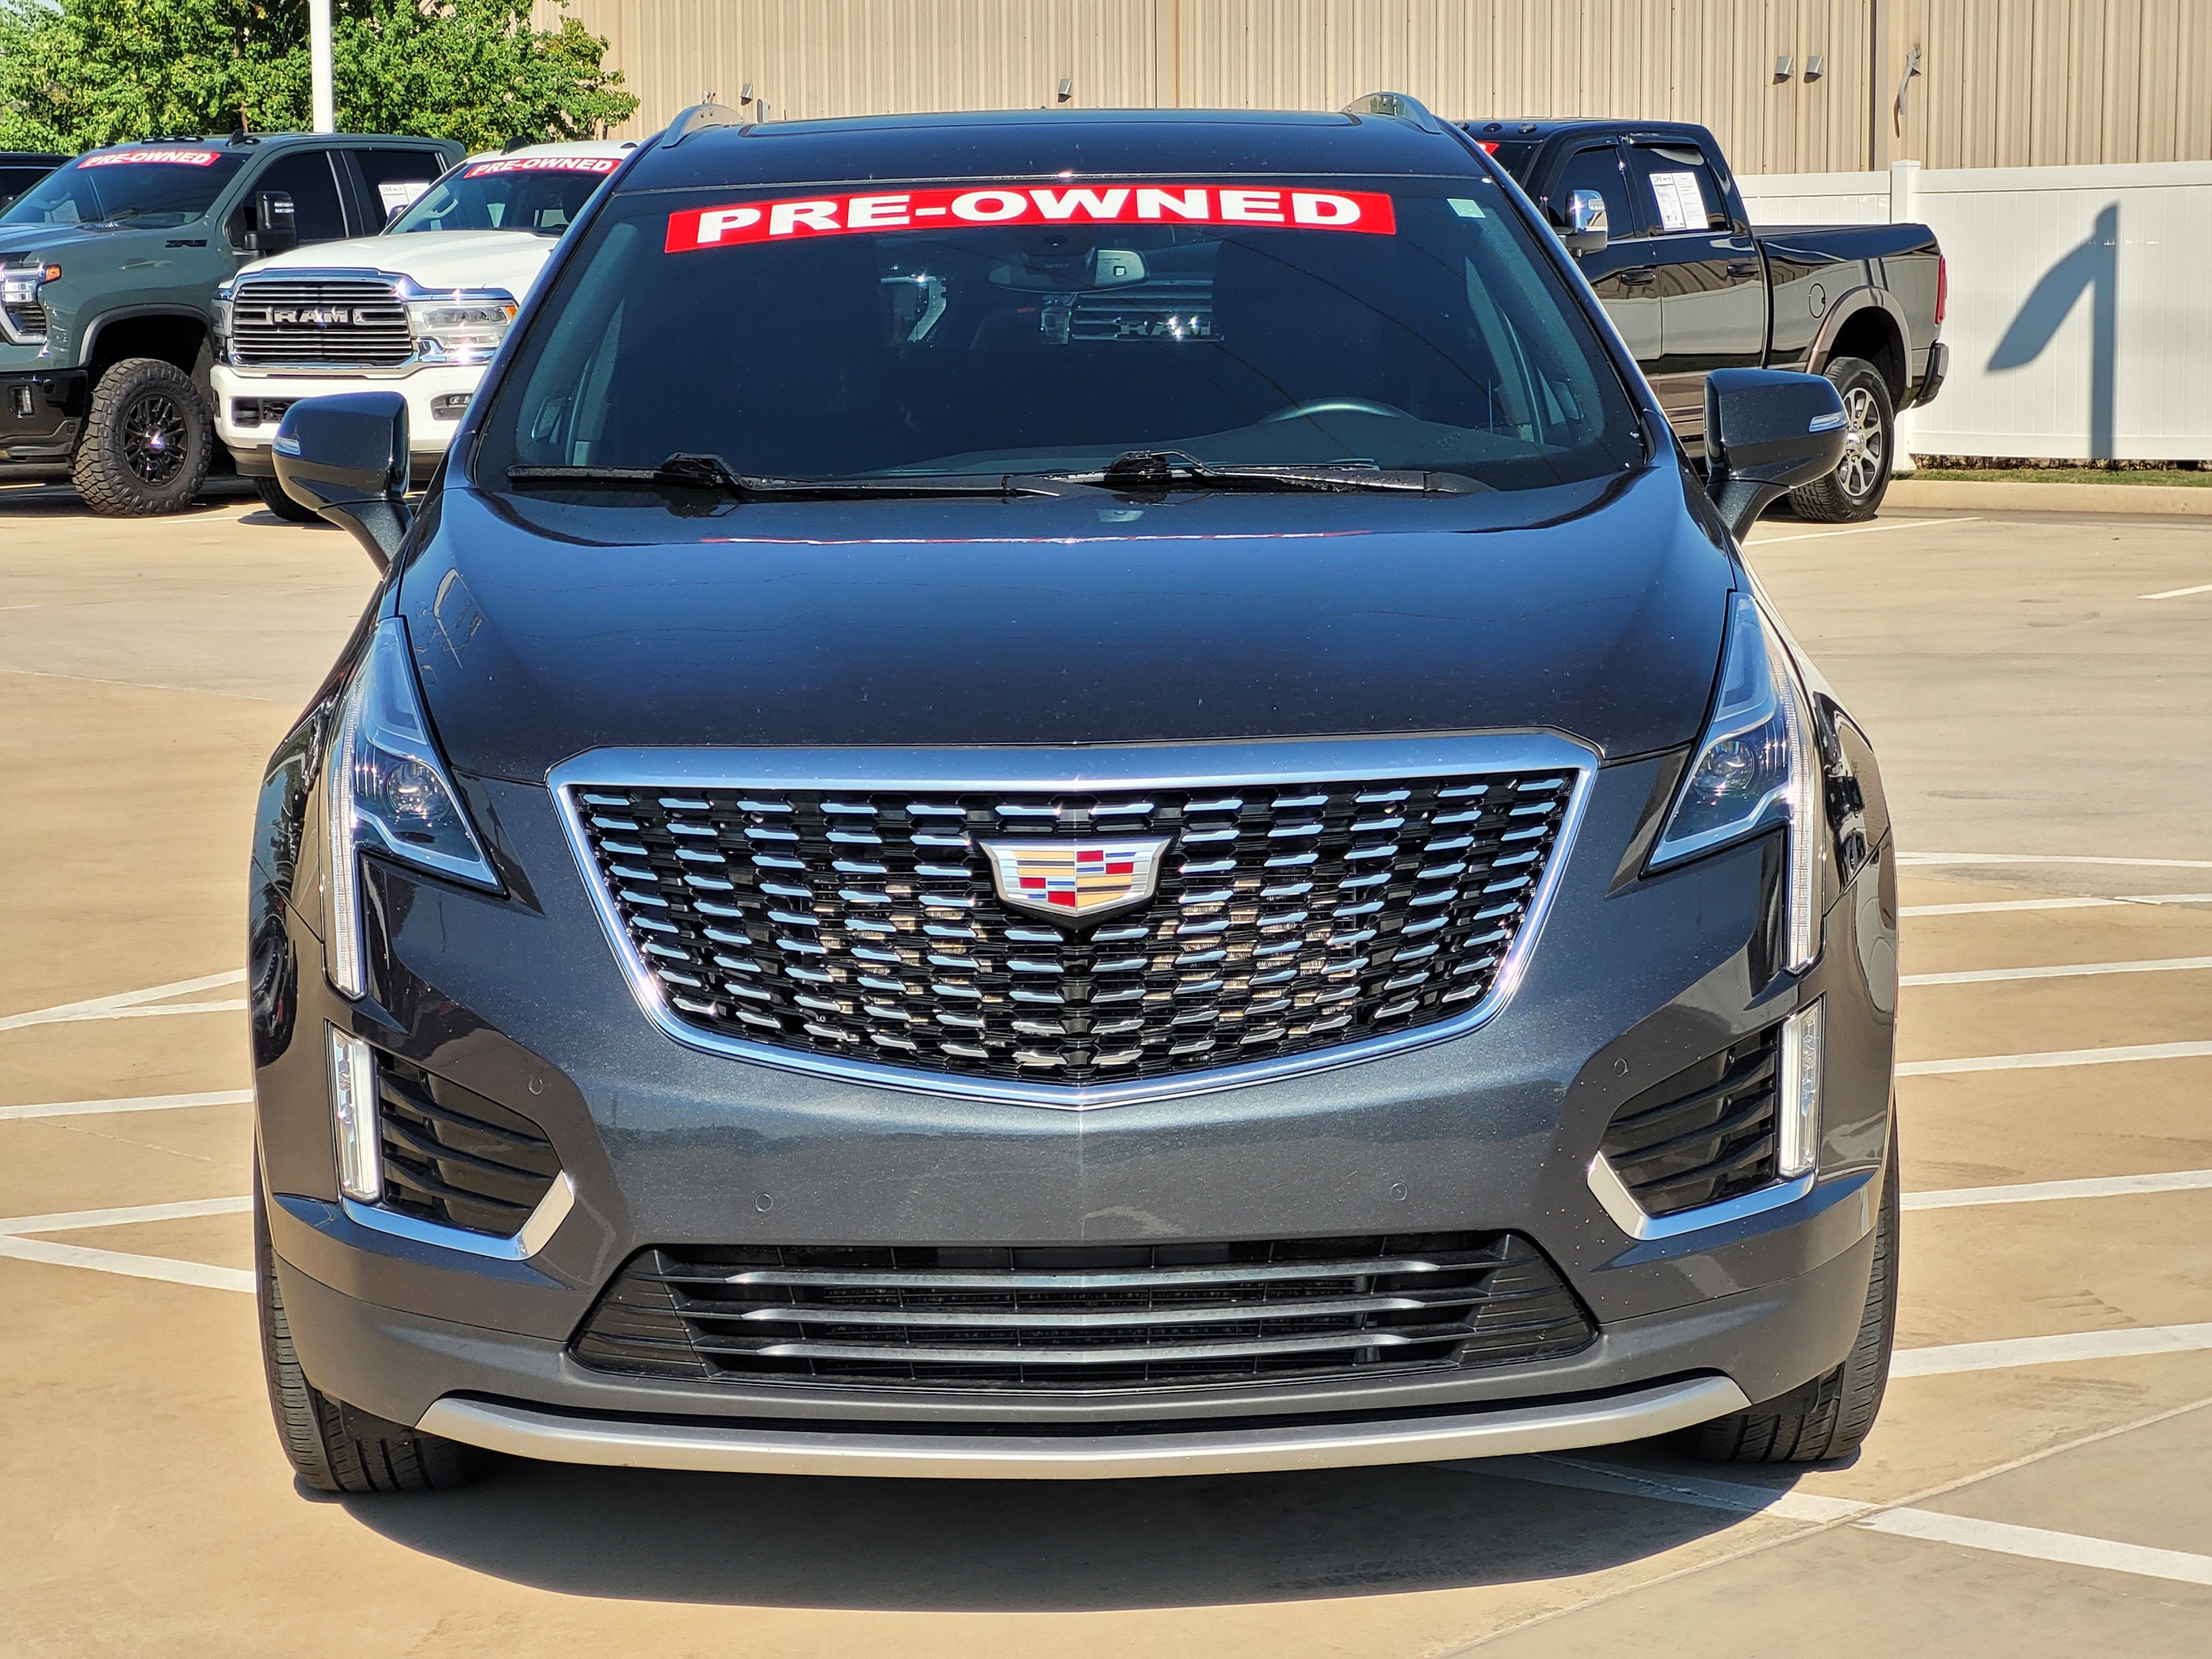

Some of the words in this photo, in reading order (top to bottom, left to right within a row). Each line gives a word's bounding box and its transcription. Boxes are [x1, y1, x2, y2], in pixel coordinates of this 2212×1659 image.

[84, 151, 212, 167] PRE-OWNED
[471, 158, 613, 176] PRE-OWNED
[696, 188, 1361, 244] PRE-OWNED
[274, 309, 348, 323] RAM
[1120, 319, 1211, 336] RAM
